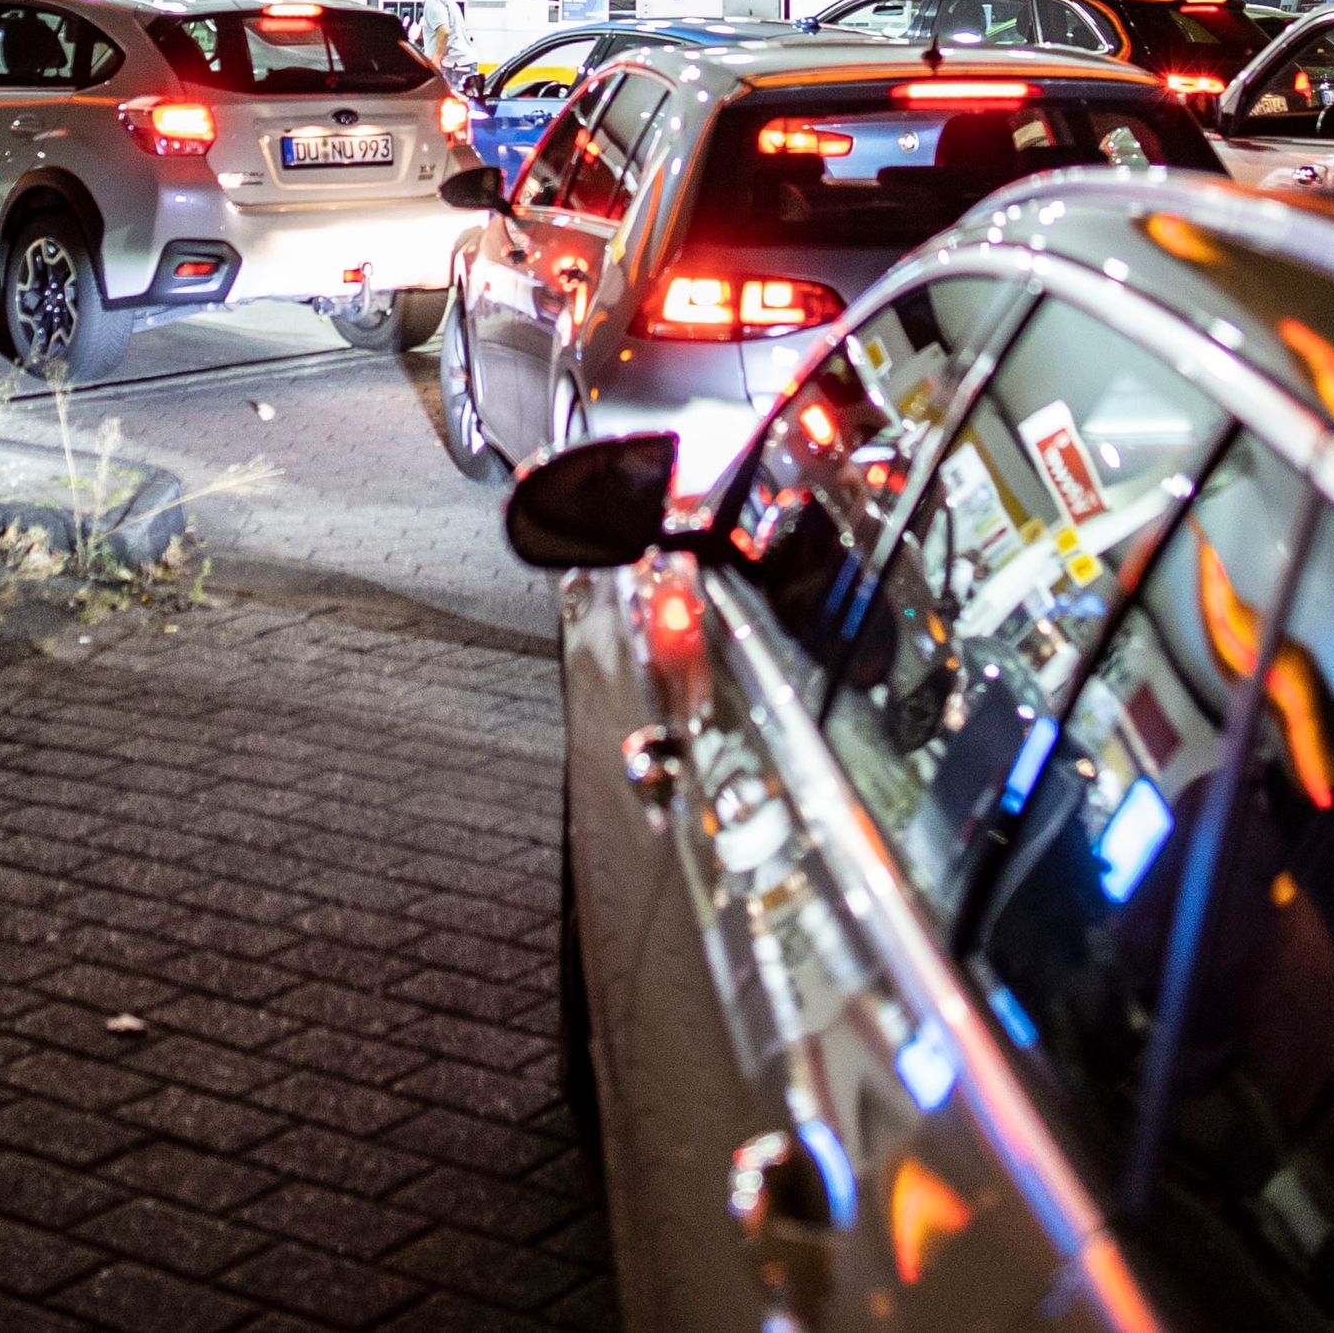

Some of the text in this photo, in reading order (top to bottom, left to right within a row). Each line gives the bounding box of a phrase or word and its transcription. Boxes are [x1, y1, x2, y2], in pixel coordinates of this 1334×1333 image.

[294, 138, 390, 161] DU NU 993
